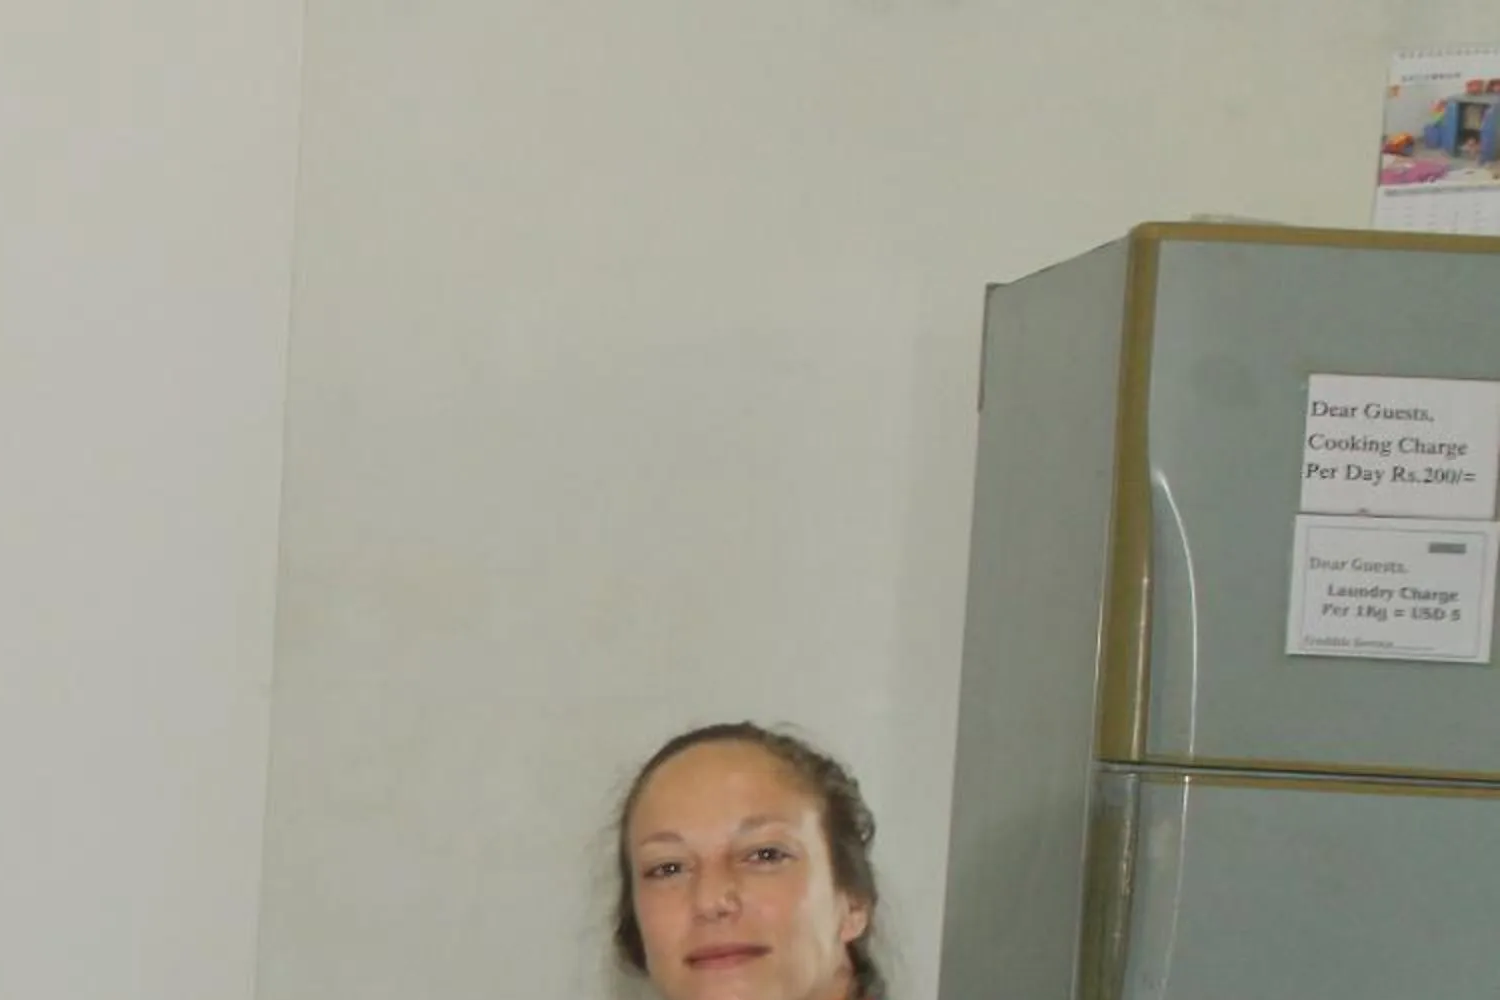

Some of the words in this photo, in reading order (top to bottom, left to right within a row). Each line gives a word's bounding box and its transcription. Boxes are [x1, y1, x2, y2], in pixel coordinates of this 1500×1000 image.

[1310, 400, 1358, 418] Dear
[1307, 433, 1393, 457] Cooking
[1398, 436, 1469, 460] Charge
[1306, 462, 1338, 479] Per
[1344, 463, 1386, 486] Day
[1309, 556, 1348, 571] Dear
[1326, 583, 1395, 602] Laundry
[1399, 586, 1460, 605] Charge
[1321, 602, 1350, 617] Per
